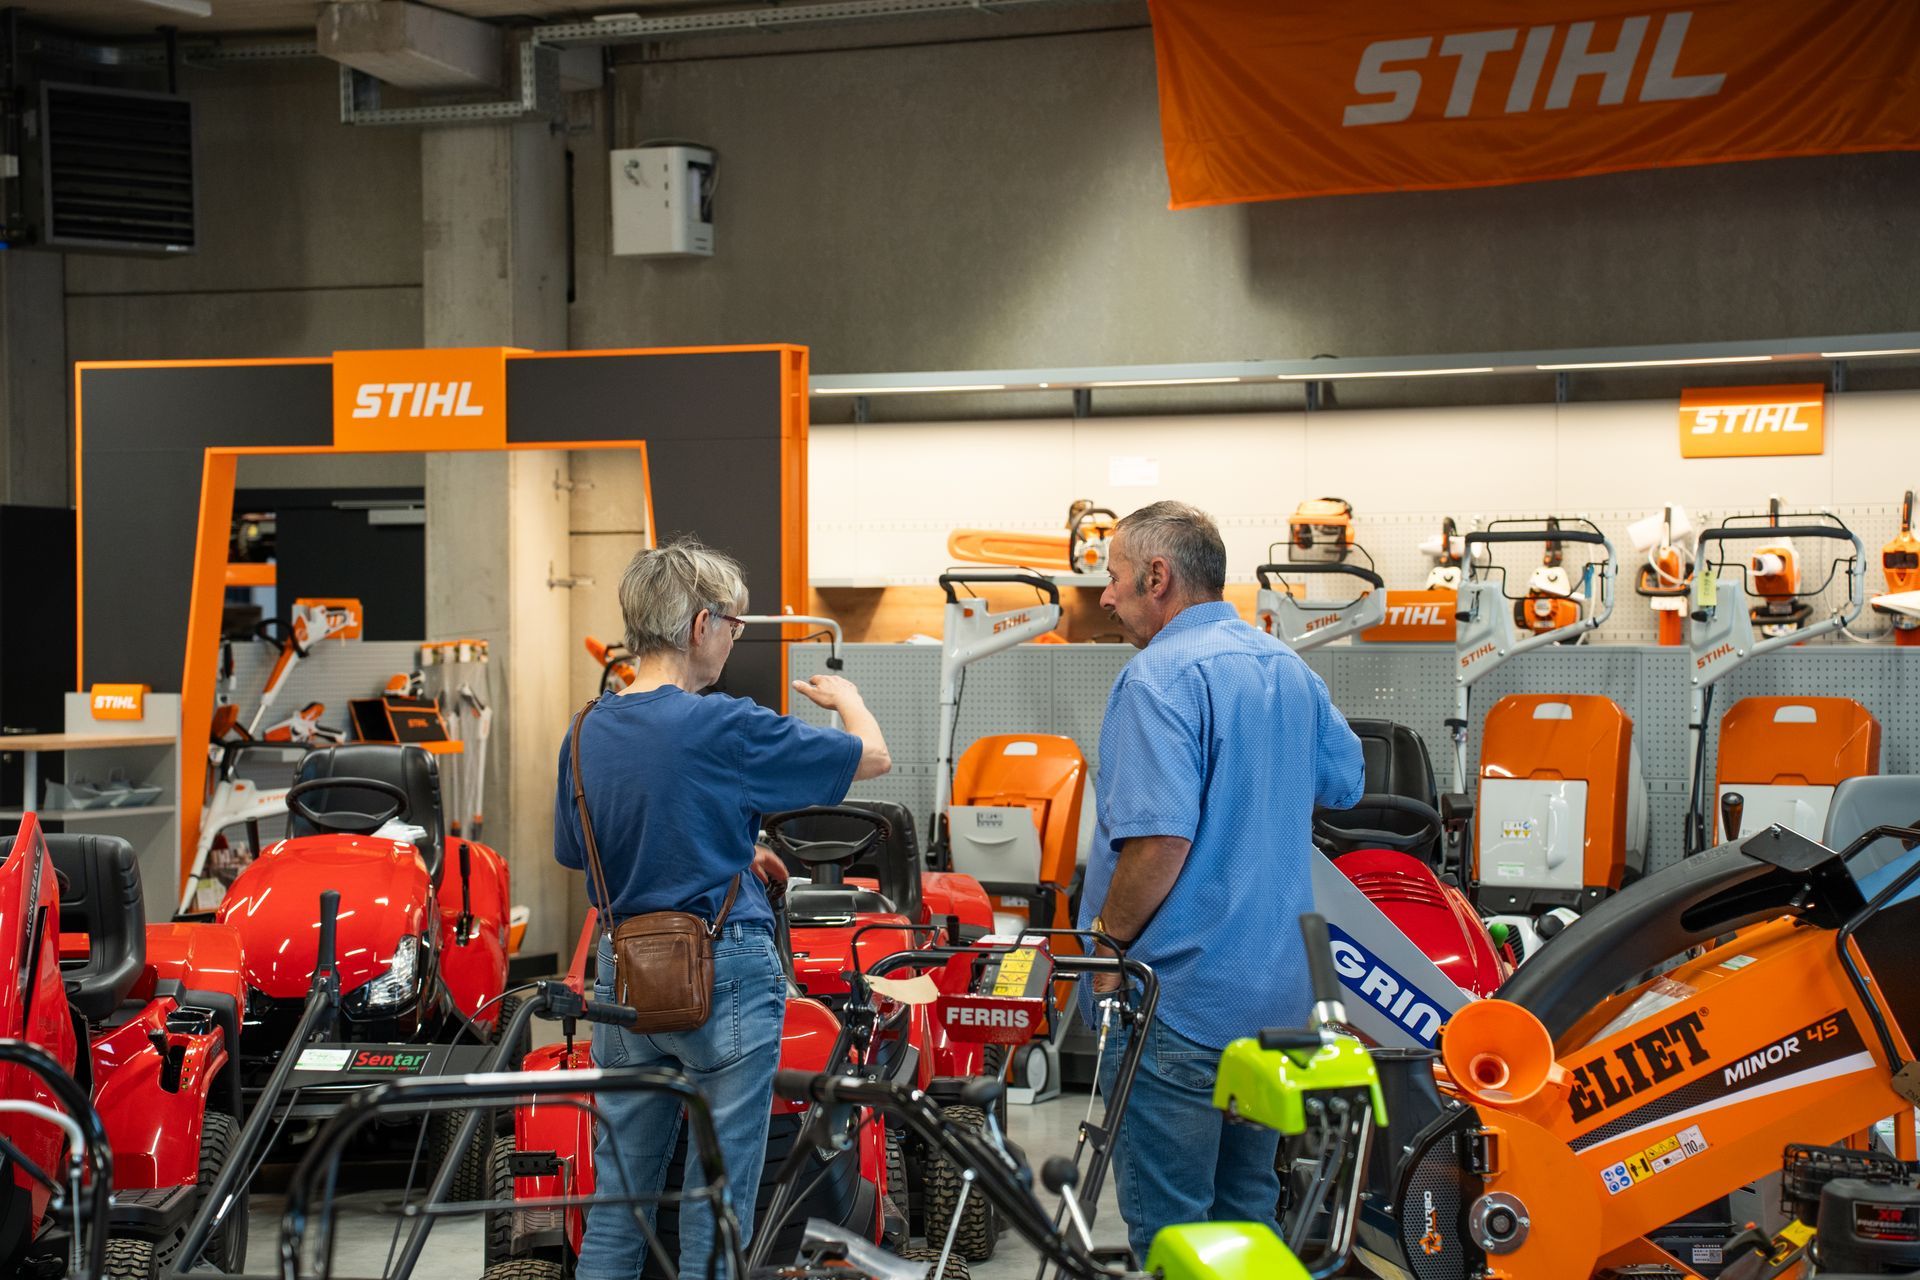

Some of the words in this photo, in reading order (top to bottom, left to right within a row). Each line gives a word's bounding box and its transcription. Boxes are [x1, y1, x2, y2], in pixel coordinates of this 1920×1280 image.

[1342, 11, 1727, 127] STIHL
[352, 382, 484, 418] STIHL
[1691, 406, 1809, 435] STIHL
[993, 613, 1030, 635] STIHL
[1306, 612, 1341, 632] STIHL
[1460, 642, 1496, 668] STIHL
[1697, 642, 1736, 670] STIHL
[94, 695, 138, 710] STIHL
[26, 862, 40, 937] MONTREAL
[946, 1007, 1029, 1028] FERRIS
[355, 1052, 424, 1066] Sentar
[1724, 1036, 1801, 1087] MINOR
[1806, 1018, 1839, 1041] 45
[1568, 1011, 1710, 1124] ELIET
[1684, 1140, 1698, 1155] 110
[1424, 1190, 1436, 1236] TURBO
